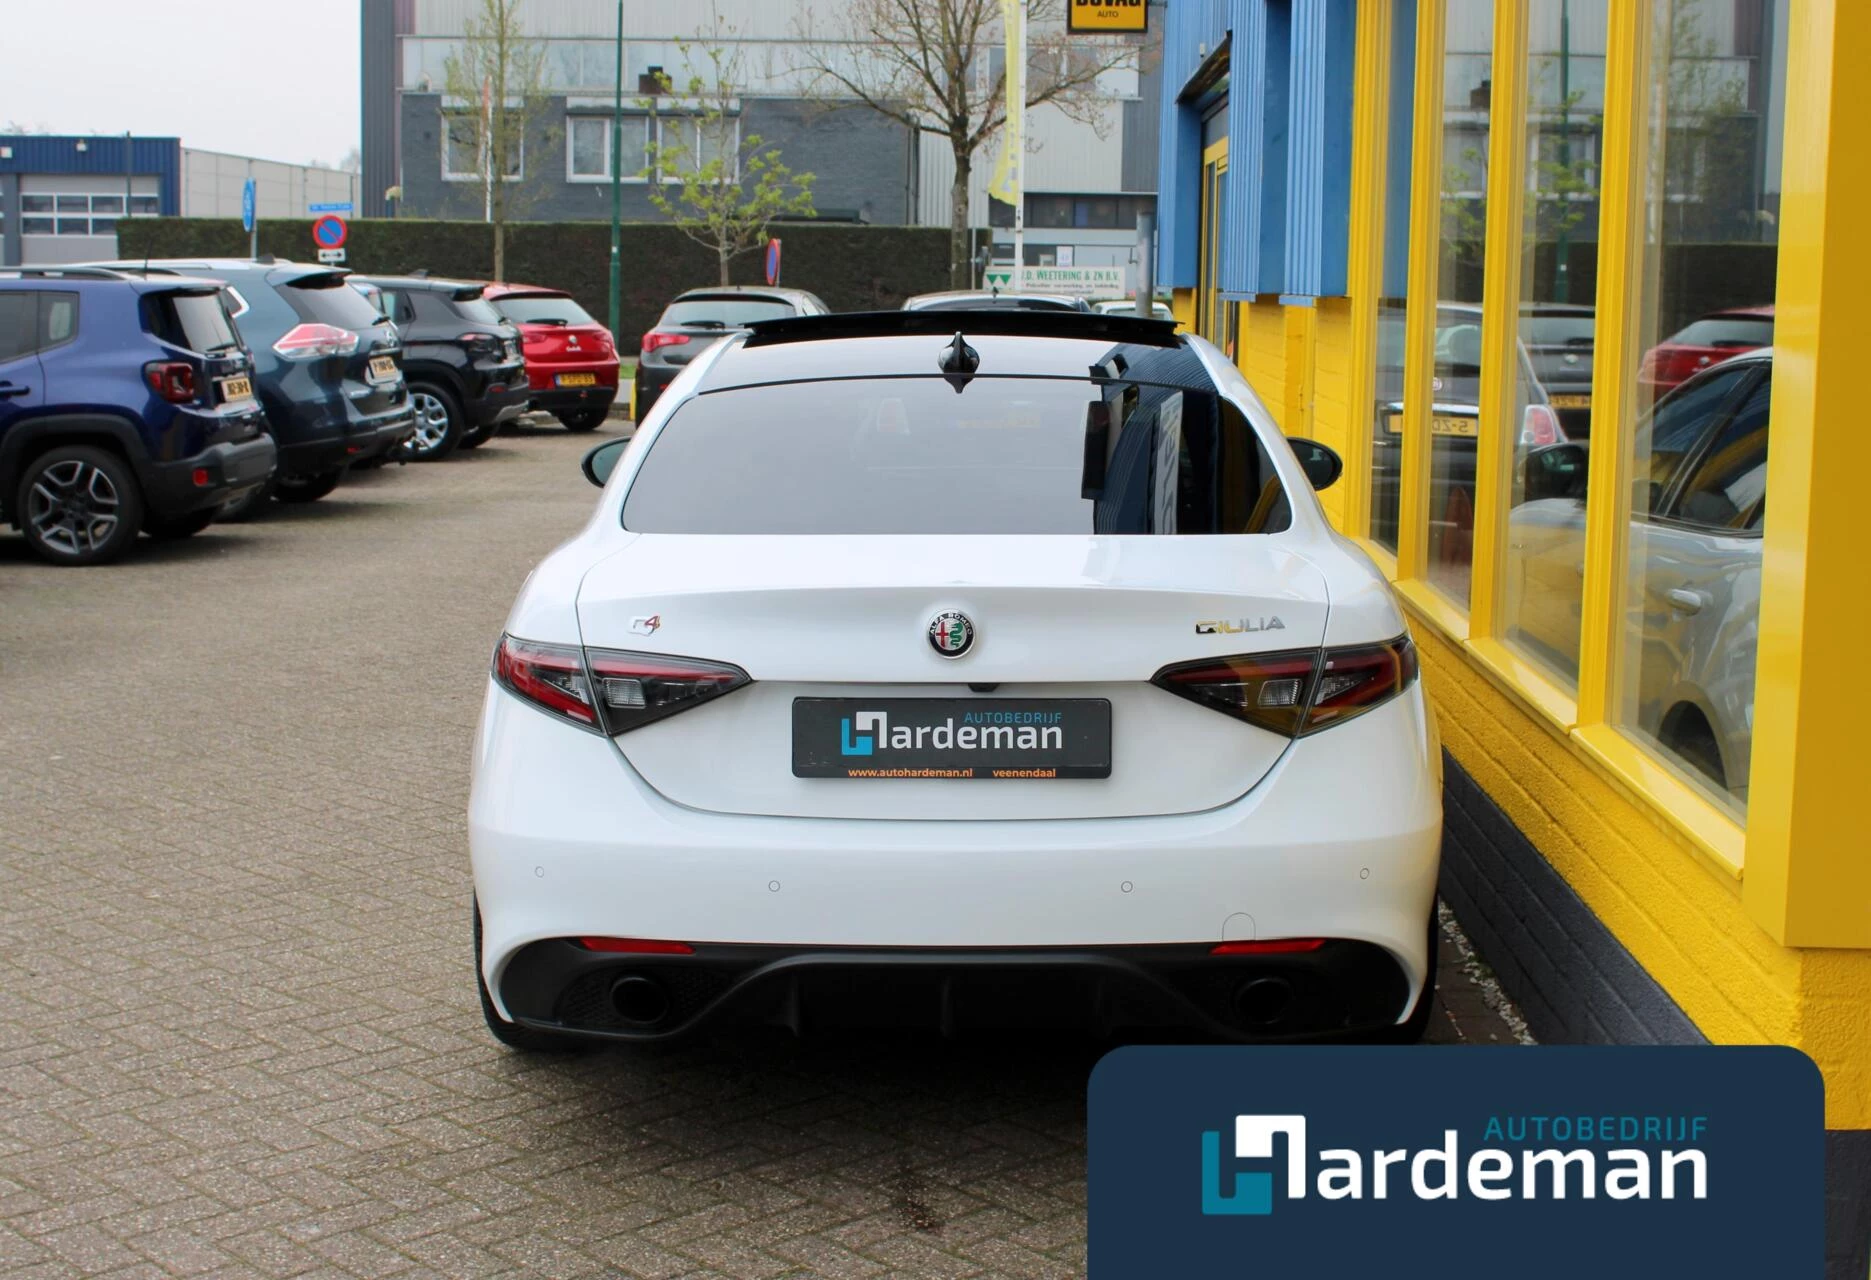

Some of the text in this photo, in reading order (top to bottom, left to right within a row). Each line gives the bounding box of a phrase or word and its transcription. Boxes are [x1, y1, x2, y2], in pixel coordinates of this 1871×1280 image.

[1097, 10, 1119, 18] AUTO
[1195, 615, 1286, 635] GIULIA
[964, 711, 1063, 724] AUTOBEDRIJF
[848, 768, 1057, 778] www.autohardeman.nl veenendaal
